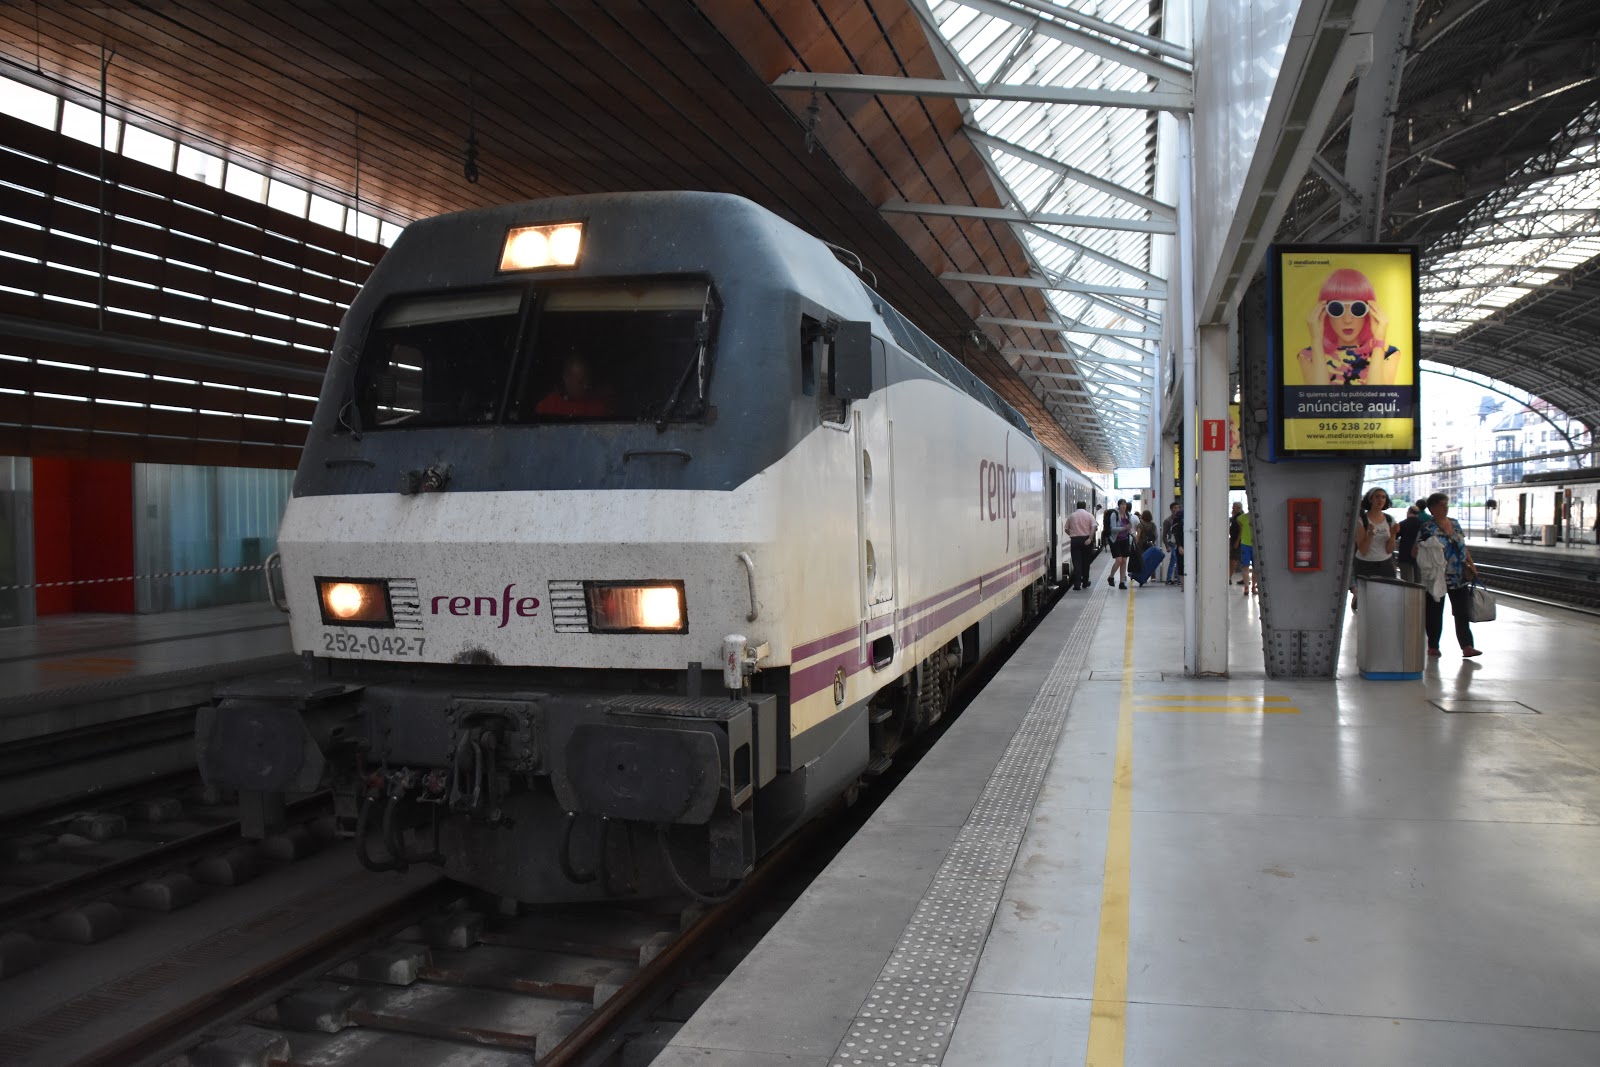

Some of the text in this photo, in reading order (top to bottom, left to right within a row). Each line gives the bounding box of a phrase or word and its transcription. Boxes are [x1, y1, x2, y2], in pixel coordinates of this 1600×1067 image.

[1306, 391, 1328, 399] quieres
[1349, 391, 1378, 399] publicidad
[1298, 399, 1400, 414] anúnciate aquí.
[1319, 422, 1382, 431] 916 238 207
[1306, 432, 1394, 440] www.mediatravelplus.es
[979, 430, 1017, 553] renfe
[431, 583, 540, 628] renfe
[323, 632, 426, 656] 252-042-7
